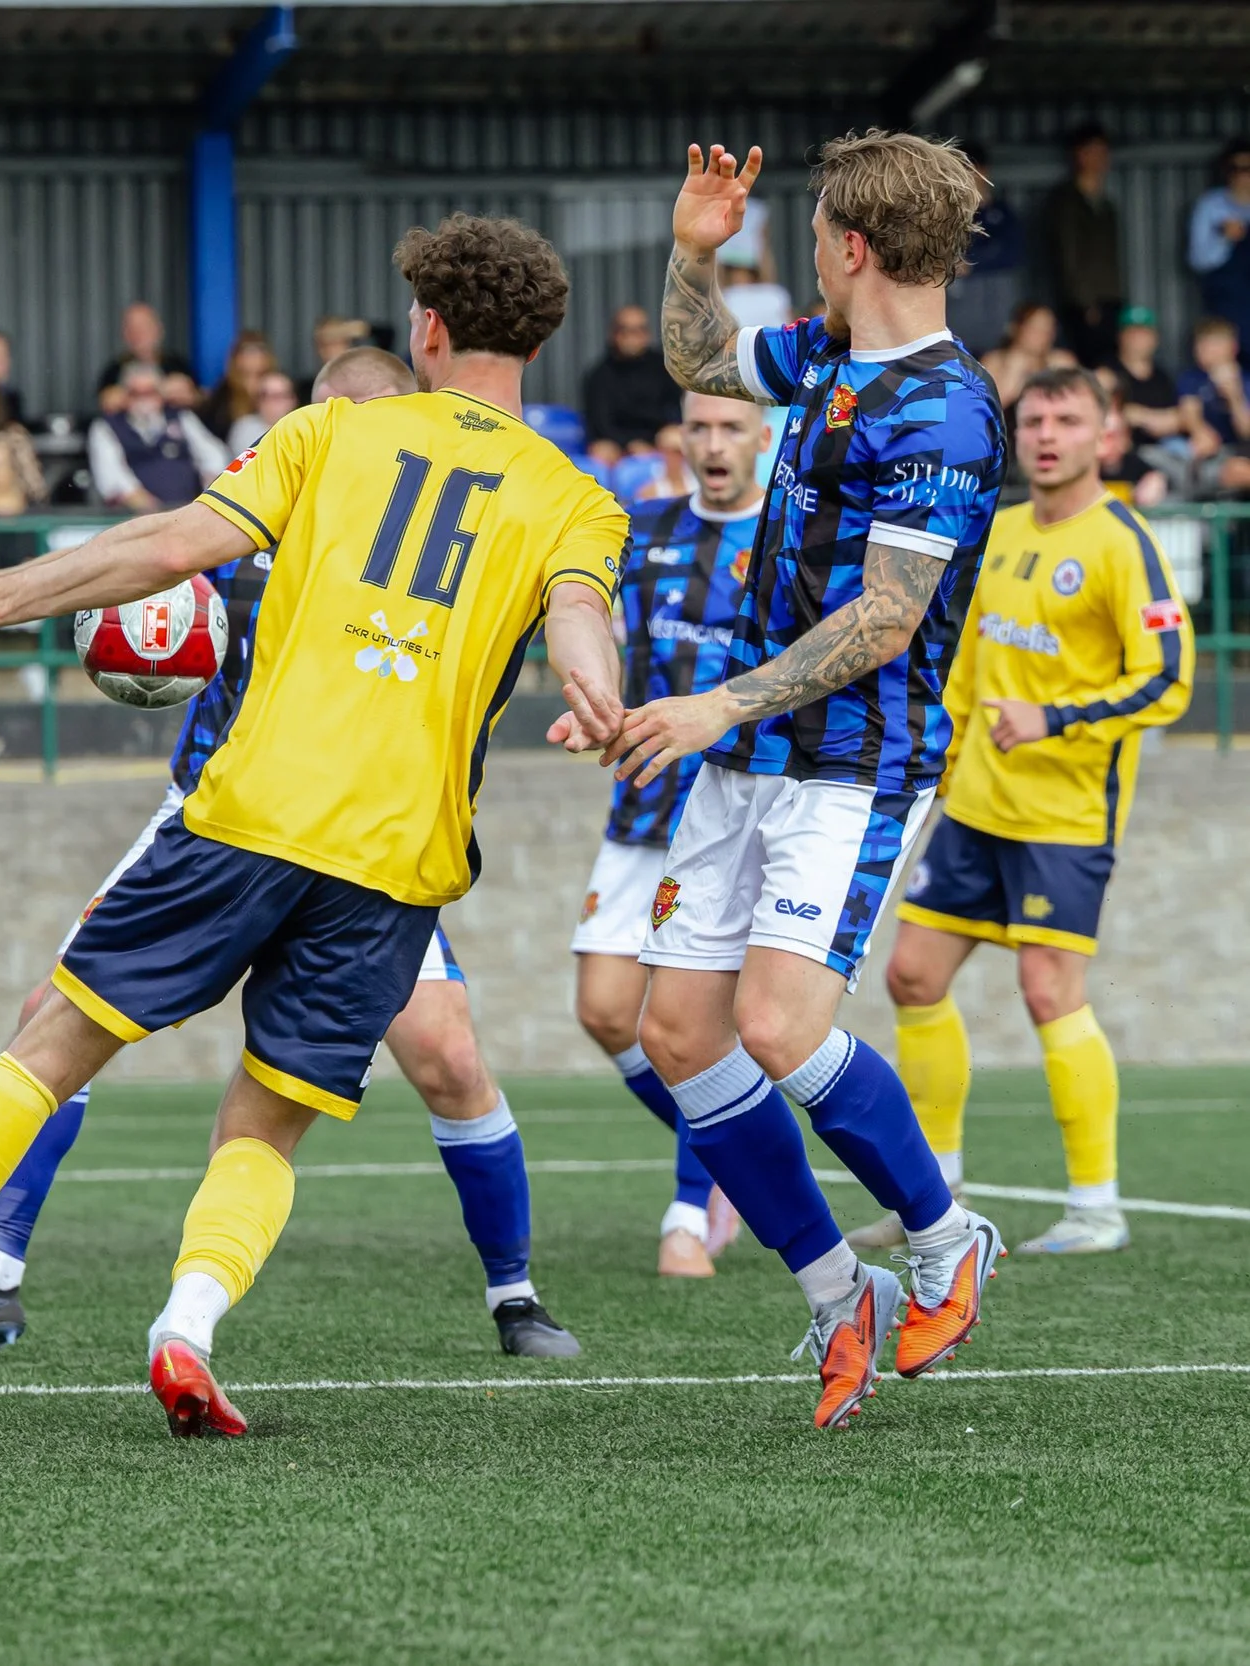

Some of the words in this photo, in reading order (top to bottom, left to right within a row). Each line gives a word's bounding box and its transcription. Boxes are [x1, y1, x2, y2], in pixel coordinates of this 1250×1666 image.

[893, 462, 980, 493] STUDIO
[360, 449, 505, 609] 16
[344, 623, 369, 639] CKR
[372, 633, 423, 654] UTILITIES
[424, 648, 441, 660] LT
